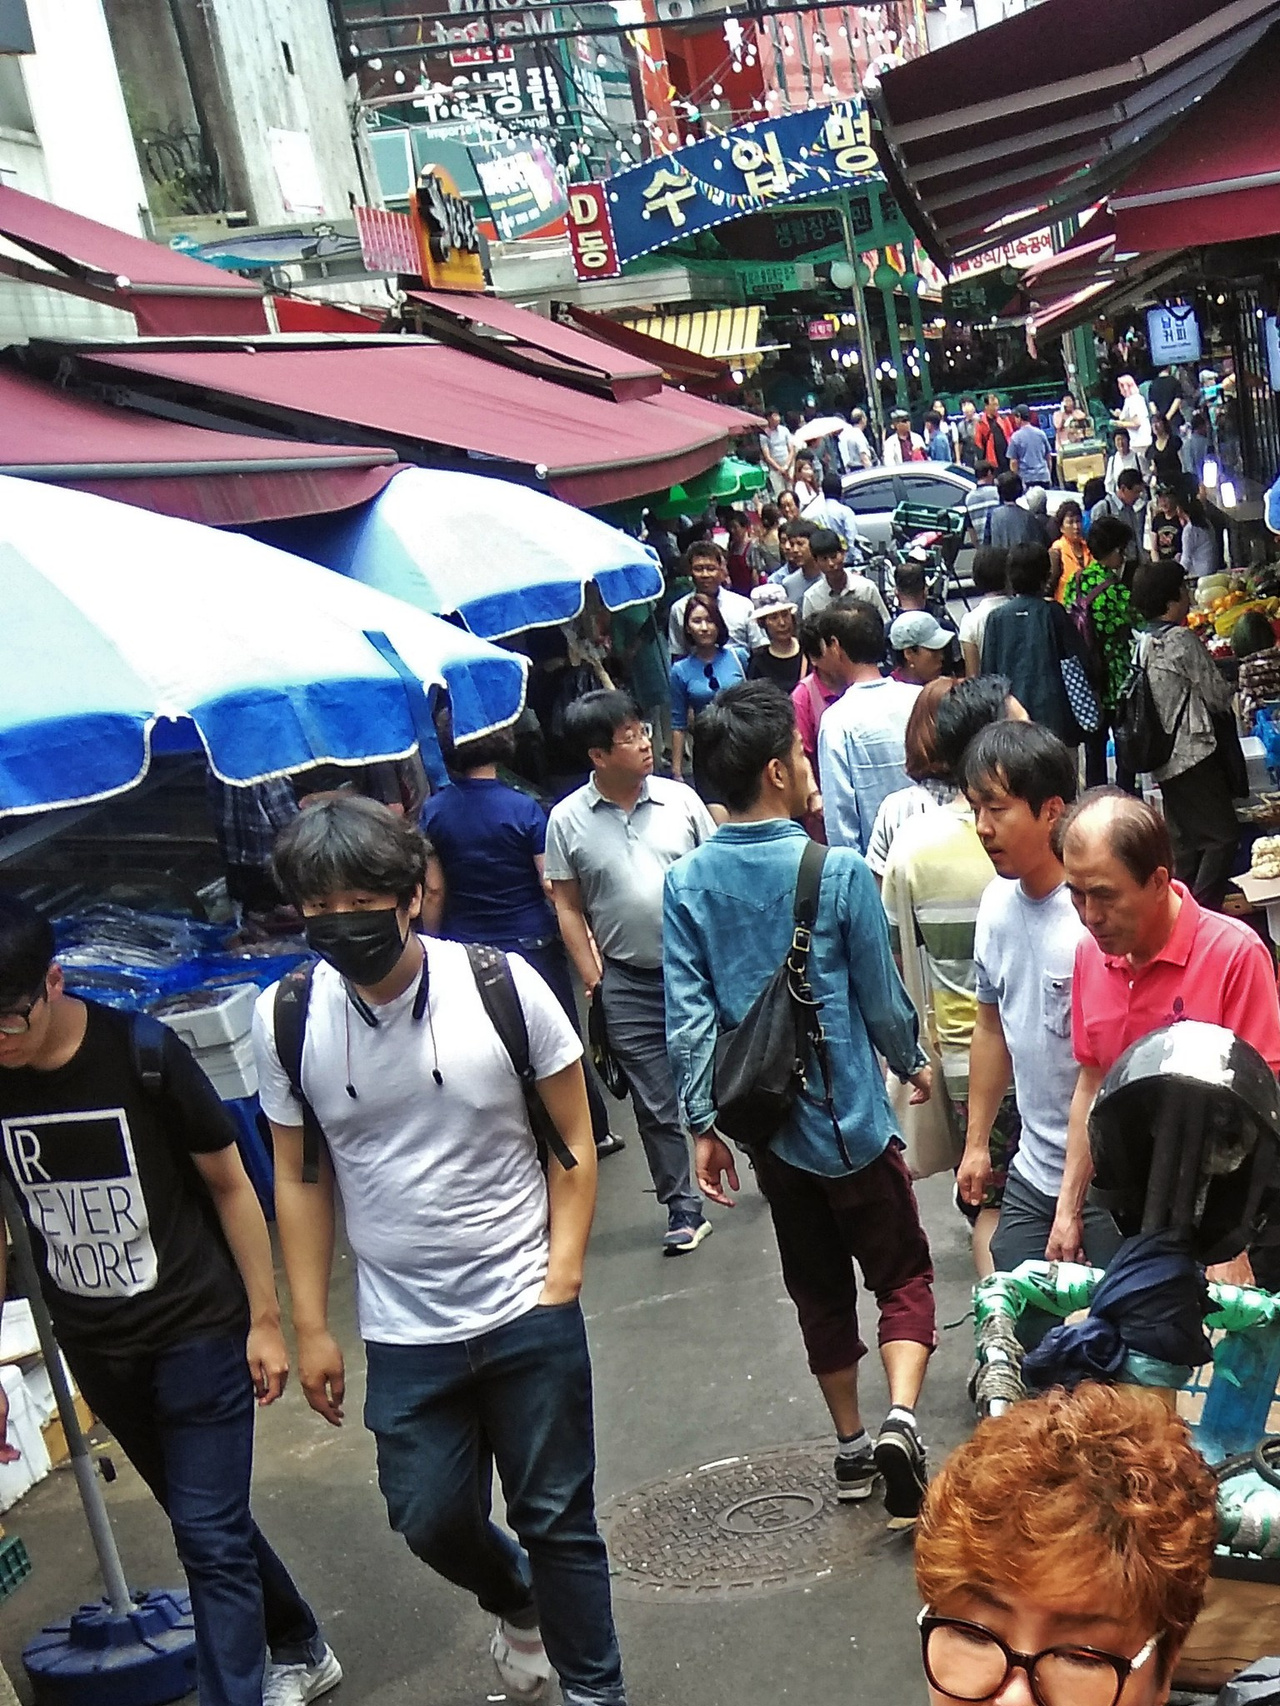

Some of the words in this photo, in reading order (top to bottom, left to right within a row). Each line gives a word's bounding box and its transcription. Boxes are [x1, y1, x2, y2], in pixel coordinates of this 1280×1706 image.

[14, 1129, 51, 1183] R
[33, 1185, 139, 1236] EVER
[52, 1236, 145, 1288] MORE
